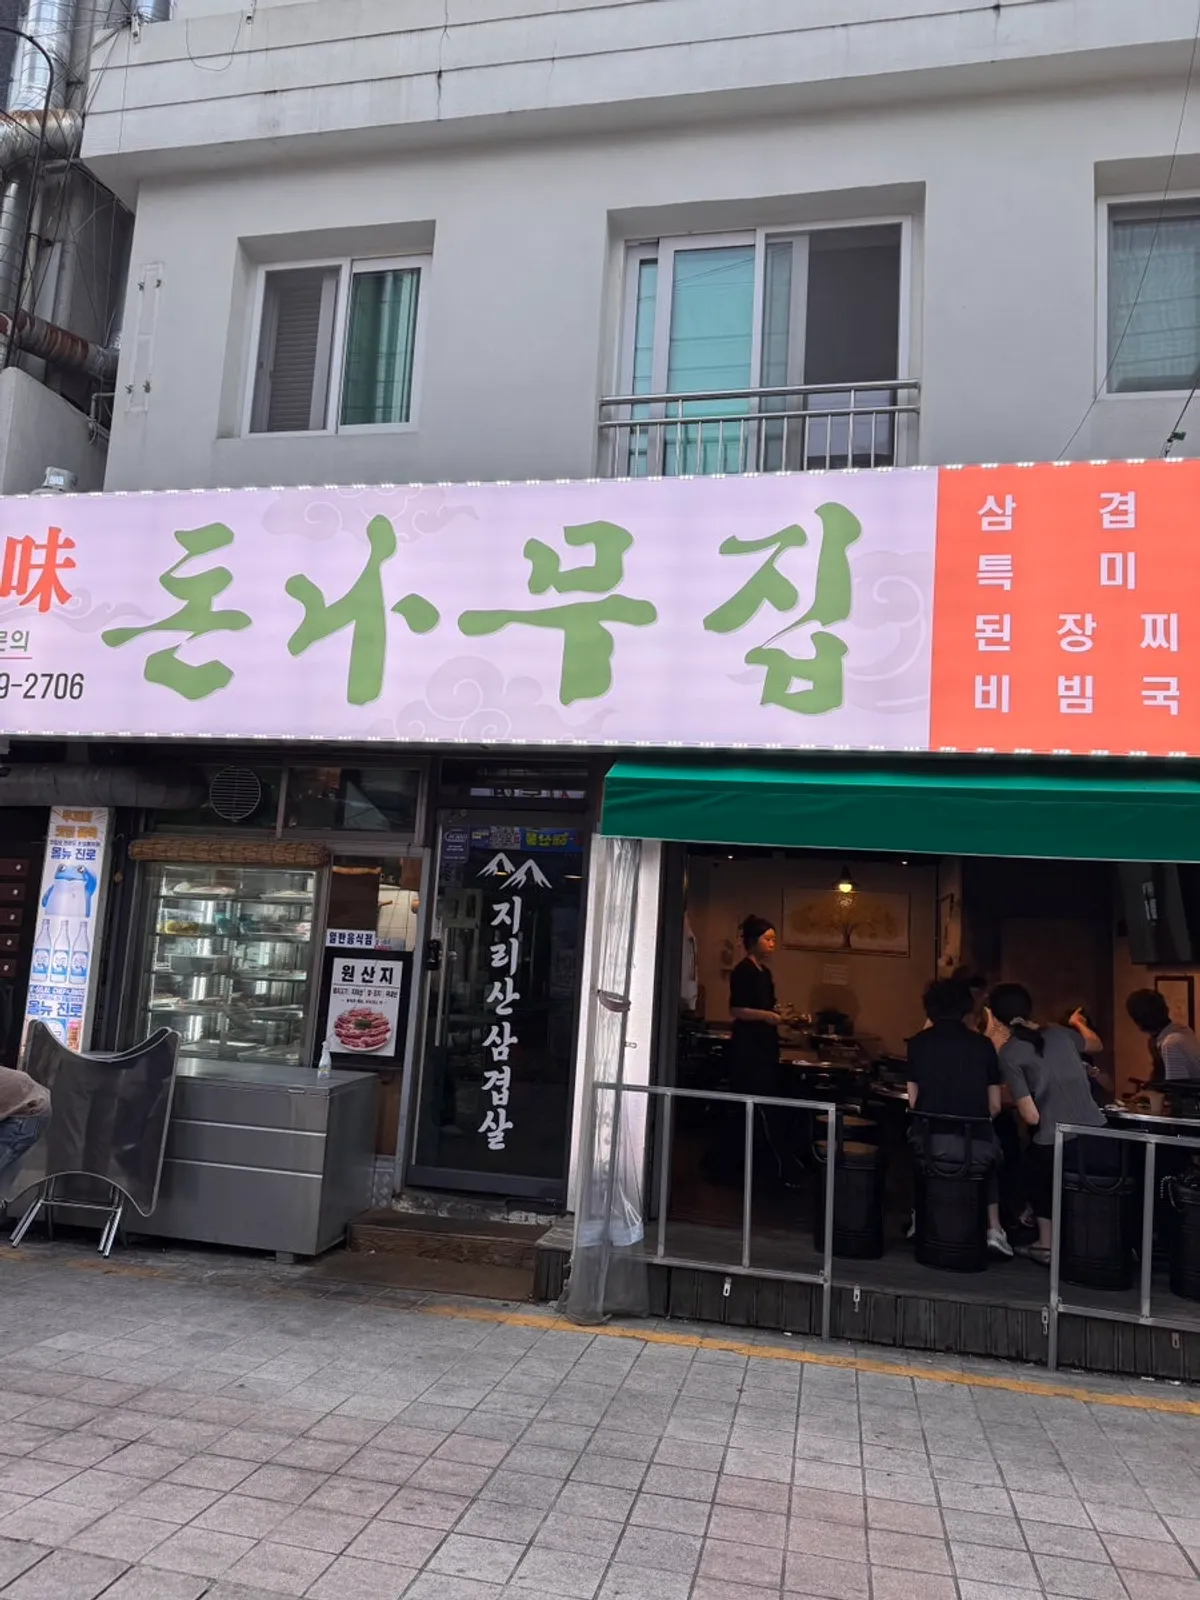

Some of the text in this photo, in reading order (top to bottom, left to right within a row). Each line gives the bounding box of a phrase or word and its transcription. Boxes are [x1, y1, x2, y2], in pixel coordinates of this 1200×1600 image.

[104, 504, 860, 714] 돈나무집
[75, 847, 97, 861] 진로
[341, 964, 394, 985] 원산지
[28, 999, 83, 1018] 올뉴 진로
[477, 895, 522, 1150] 지리산삼겹살
